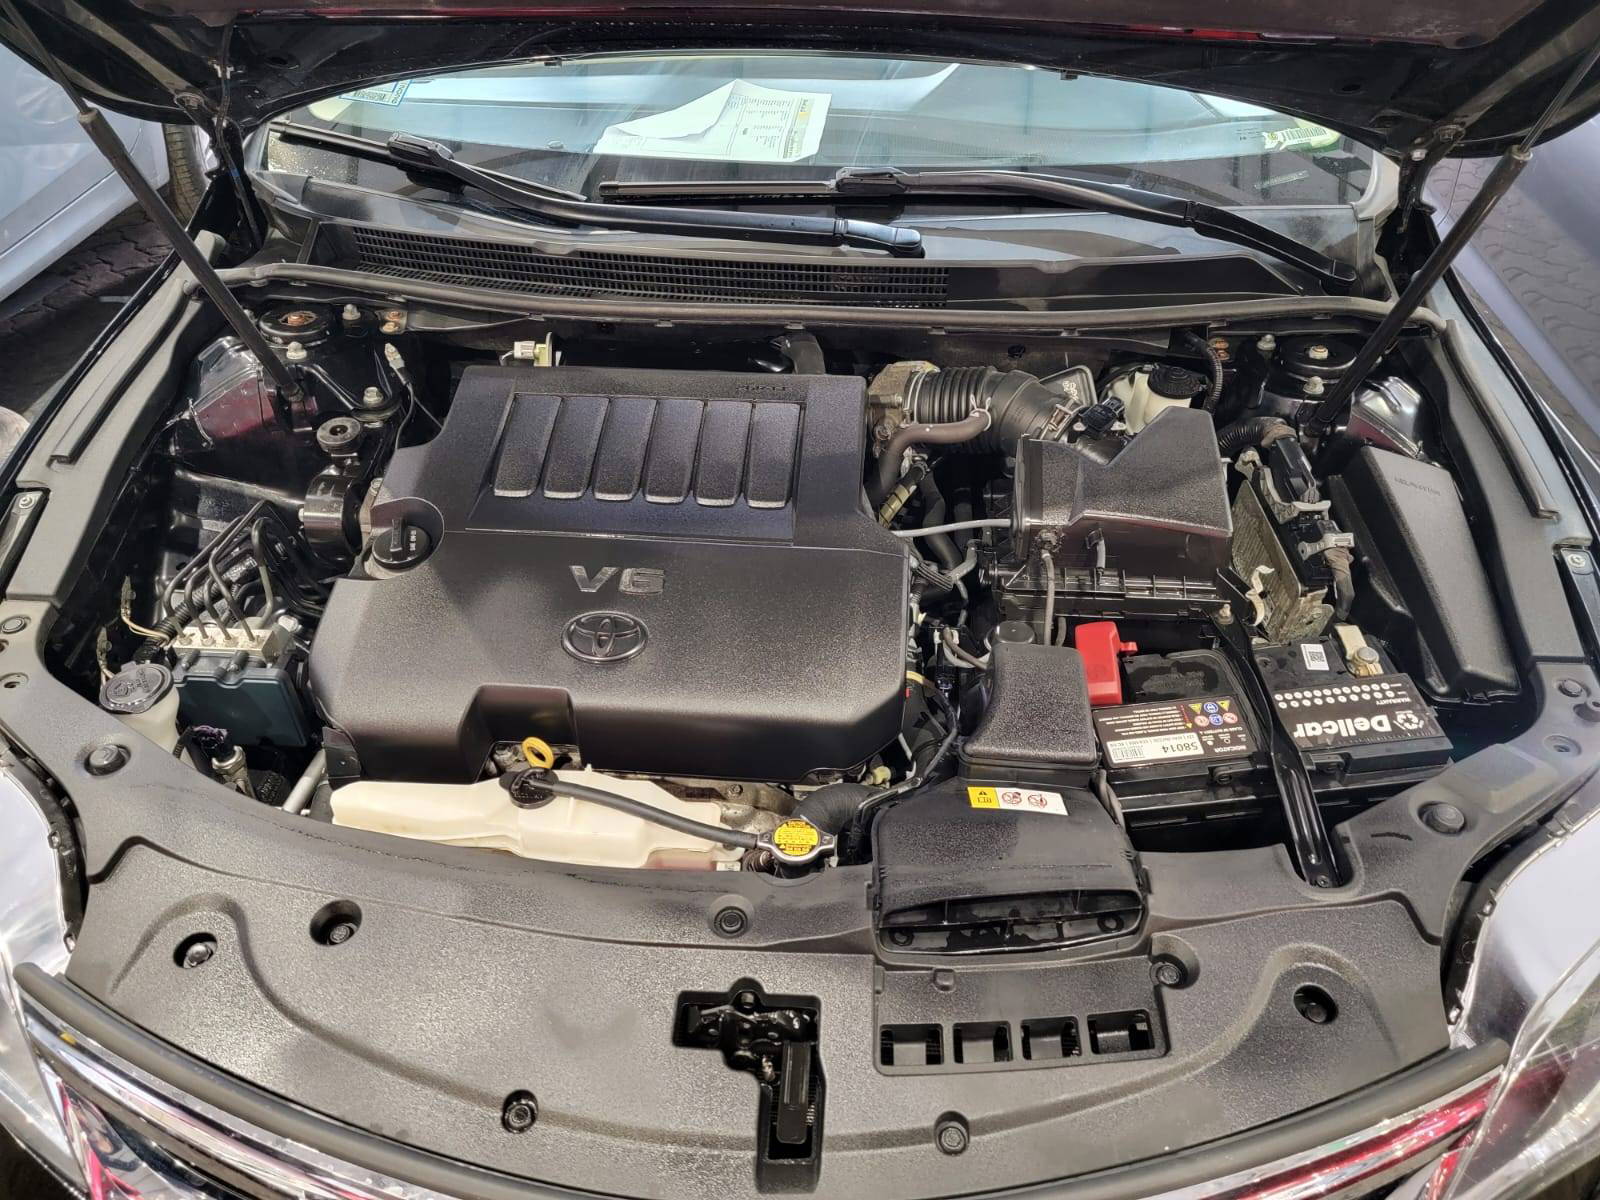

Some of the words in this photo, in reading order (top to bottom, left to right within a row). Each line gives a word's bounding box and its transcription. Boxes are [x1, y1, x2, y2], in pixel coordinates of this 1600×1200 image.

[569, 565, 665, 594] V6
[1293, 714, 1392, 738] Dellcar
[1162, 741, 1199, 753] 58014
